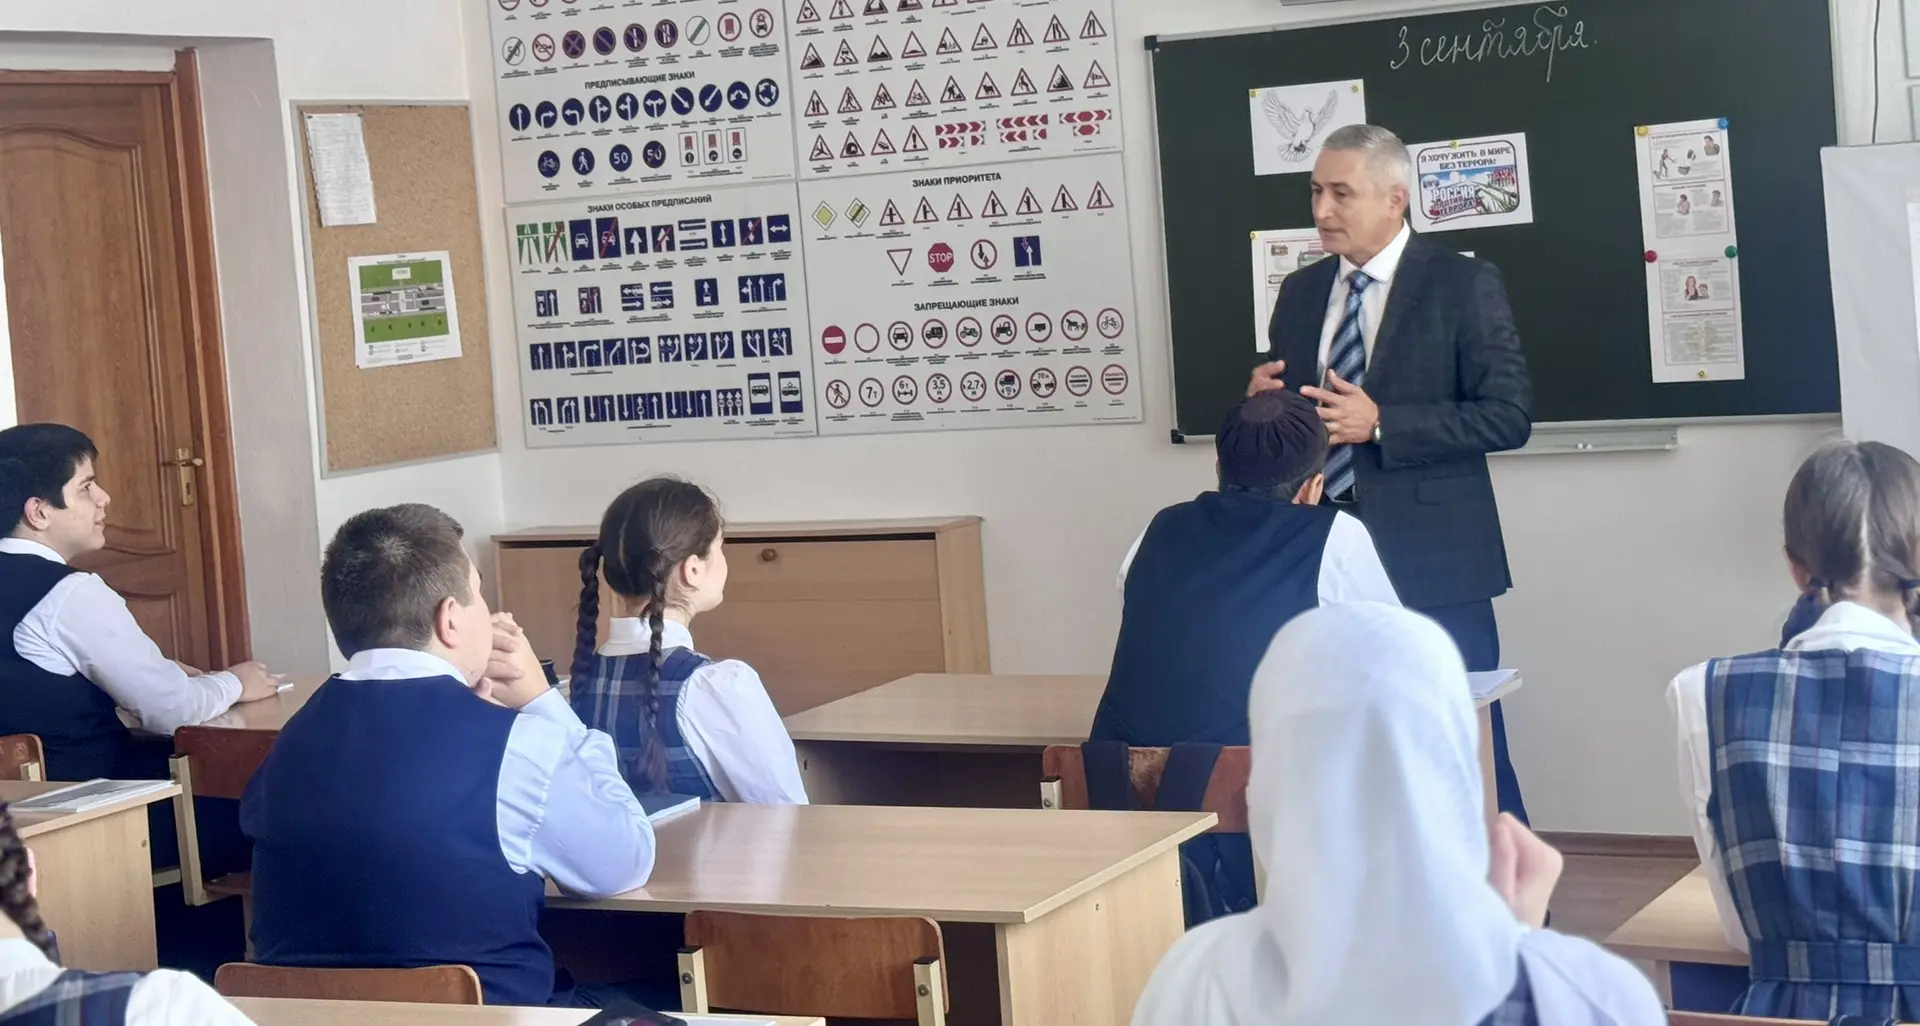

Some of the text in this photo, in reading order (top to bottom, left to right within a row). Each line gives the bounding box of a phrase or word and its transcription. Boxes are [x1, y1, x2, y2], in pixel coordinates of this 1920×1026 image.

[1389, 25, 1410, 69] 3
[584, 71, 696, 89] ПРЕДПИСЫВАЮЩИЕ ЗНАКИ
[613, 151, 628, 165] 50
[1420, 146, 1511, 163] Я ХОЧУ ЖИТЬ В МИРЕ
[1439, 162, 1456, 170] БЕЗ
[912, 172, 1002, 187] ЗНАКИ ПРИОРИТЕТА
[1431, 185, 1475, 203] РОССИЯ
[587, 193, 712, 213] ЗНАКИ ОСОБЫХ ПРЕДПИСАНИЙ
[929, 252, 953, 264] STOP
[913, 297, 1019, 312] ЗАПРЕЩАЮЩИЕ ЗНАКИ
